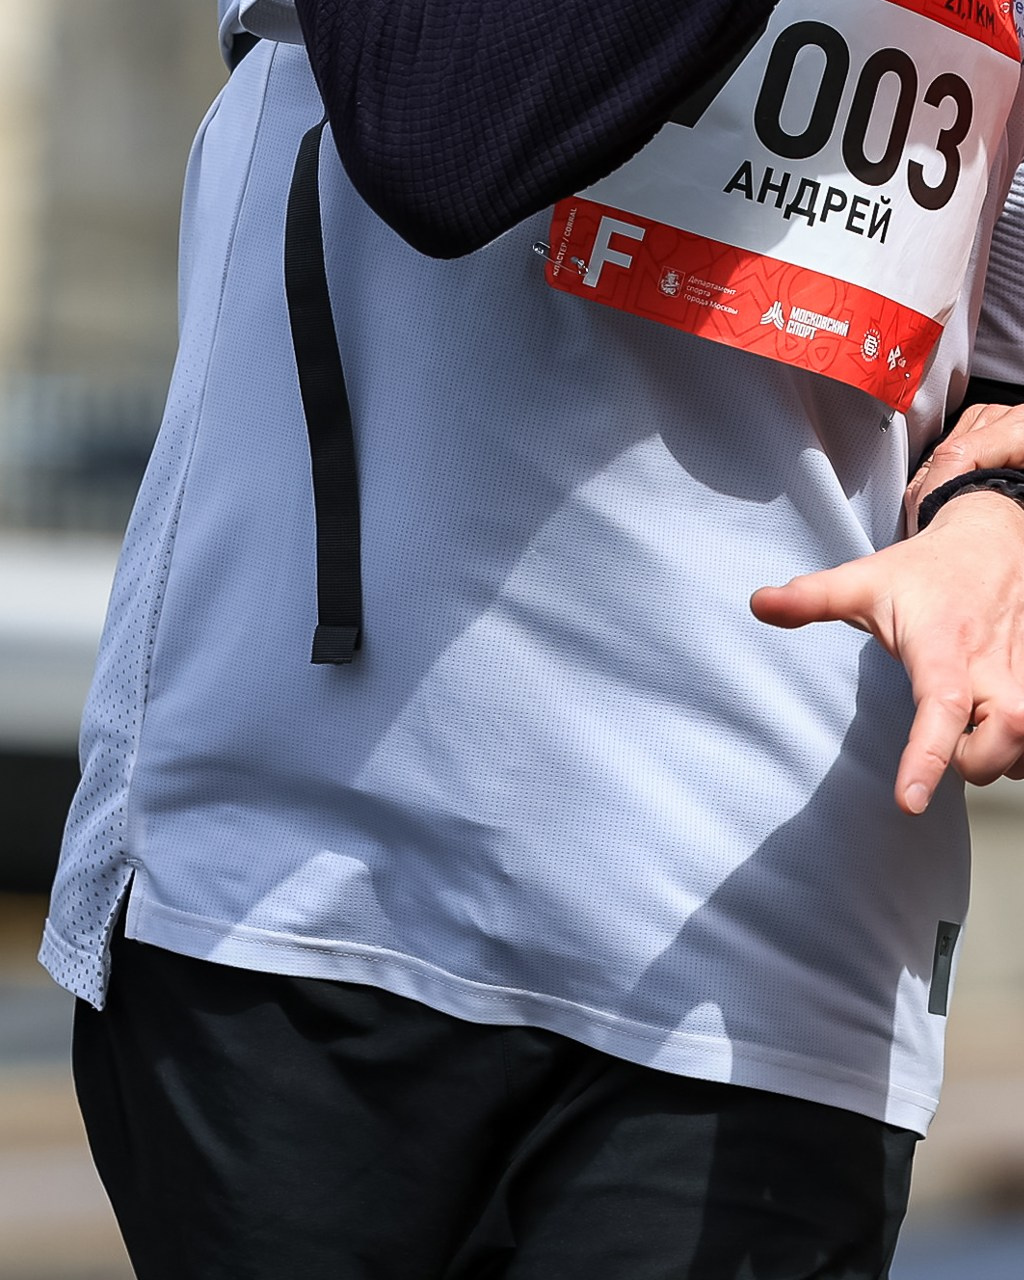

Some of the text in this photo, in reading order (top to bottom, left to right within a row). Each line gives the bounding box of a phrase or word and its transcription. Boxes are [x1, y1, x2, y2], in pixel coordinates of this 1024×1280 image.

[723, 160, 892, 245] АНДРЕЙ
[582, 215, 646, 288] F
[785, 320, 818, 341] СПОРТ
[789, 306, 850, 337] МОСКОВСКИЙ
